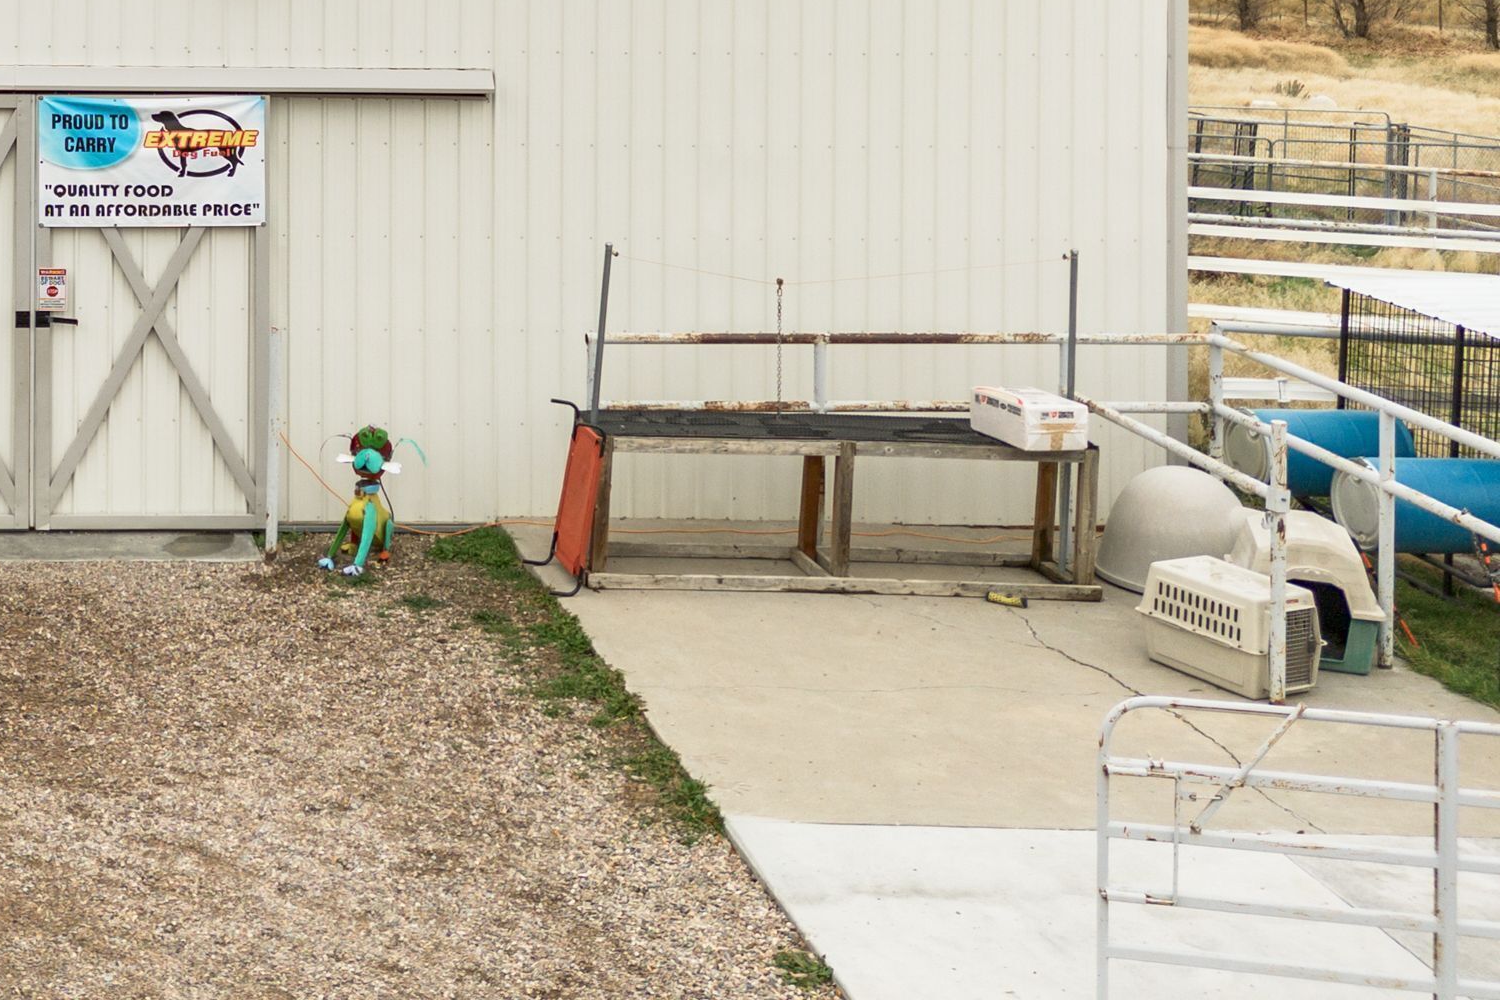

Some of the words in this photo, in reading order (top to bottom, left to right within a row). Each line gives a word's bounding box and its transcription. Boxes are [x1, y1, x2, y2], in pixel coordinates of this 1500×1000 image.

[52, 114, 105, 130] PROUD
[109, 114, 129, 130] TO
[64, 137, 116, 153] CARRY
[144, 129, 259, 149] EXTREME
[172, 149, 198, 159] Dog
[202, 149, 231, 158] Fuel
[44, 184, 119, 198] "QUALITY
[124, 185, 174, 198] FOOD
[44, 204, 65, 217] AT
[69, 204, 90, 217] AN
[95, 204, 197, 217] AFFORDABLE
[202, 203, 260, 217] PRICE"
